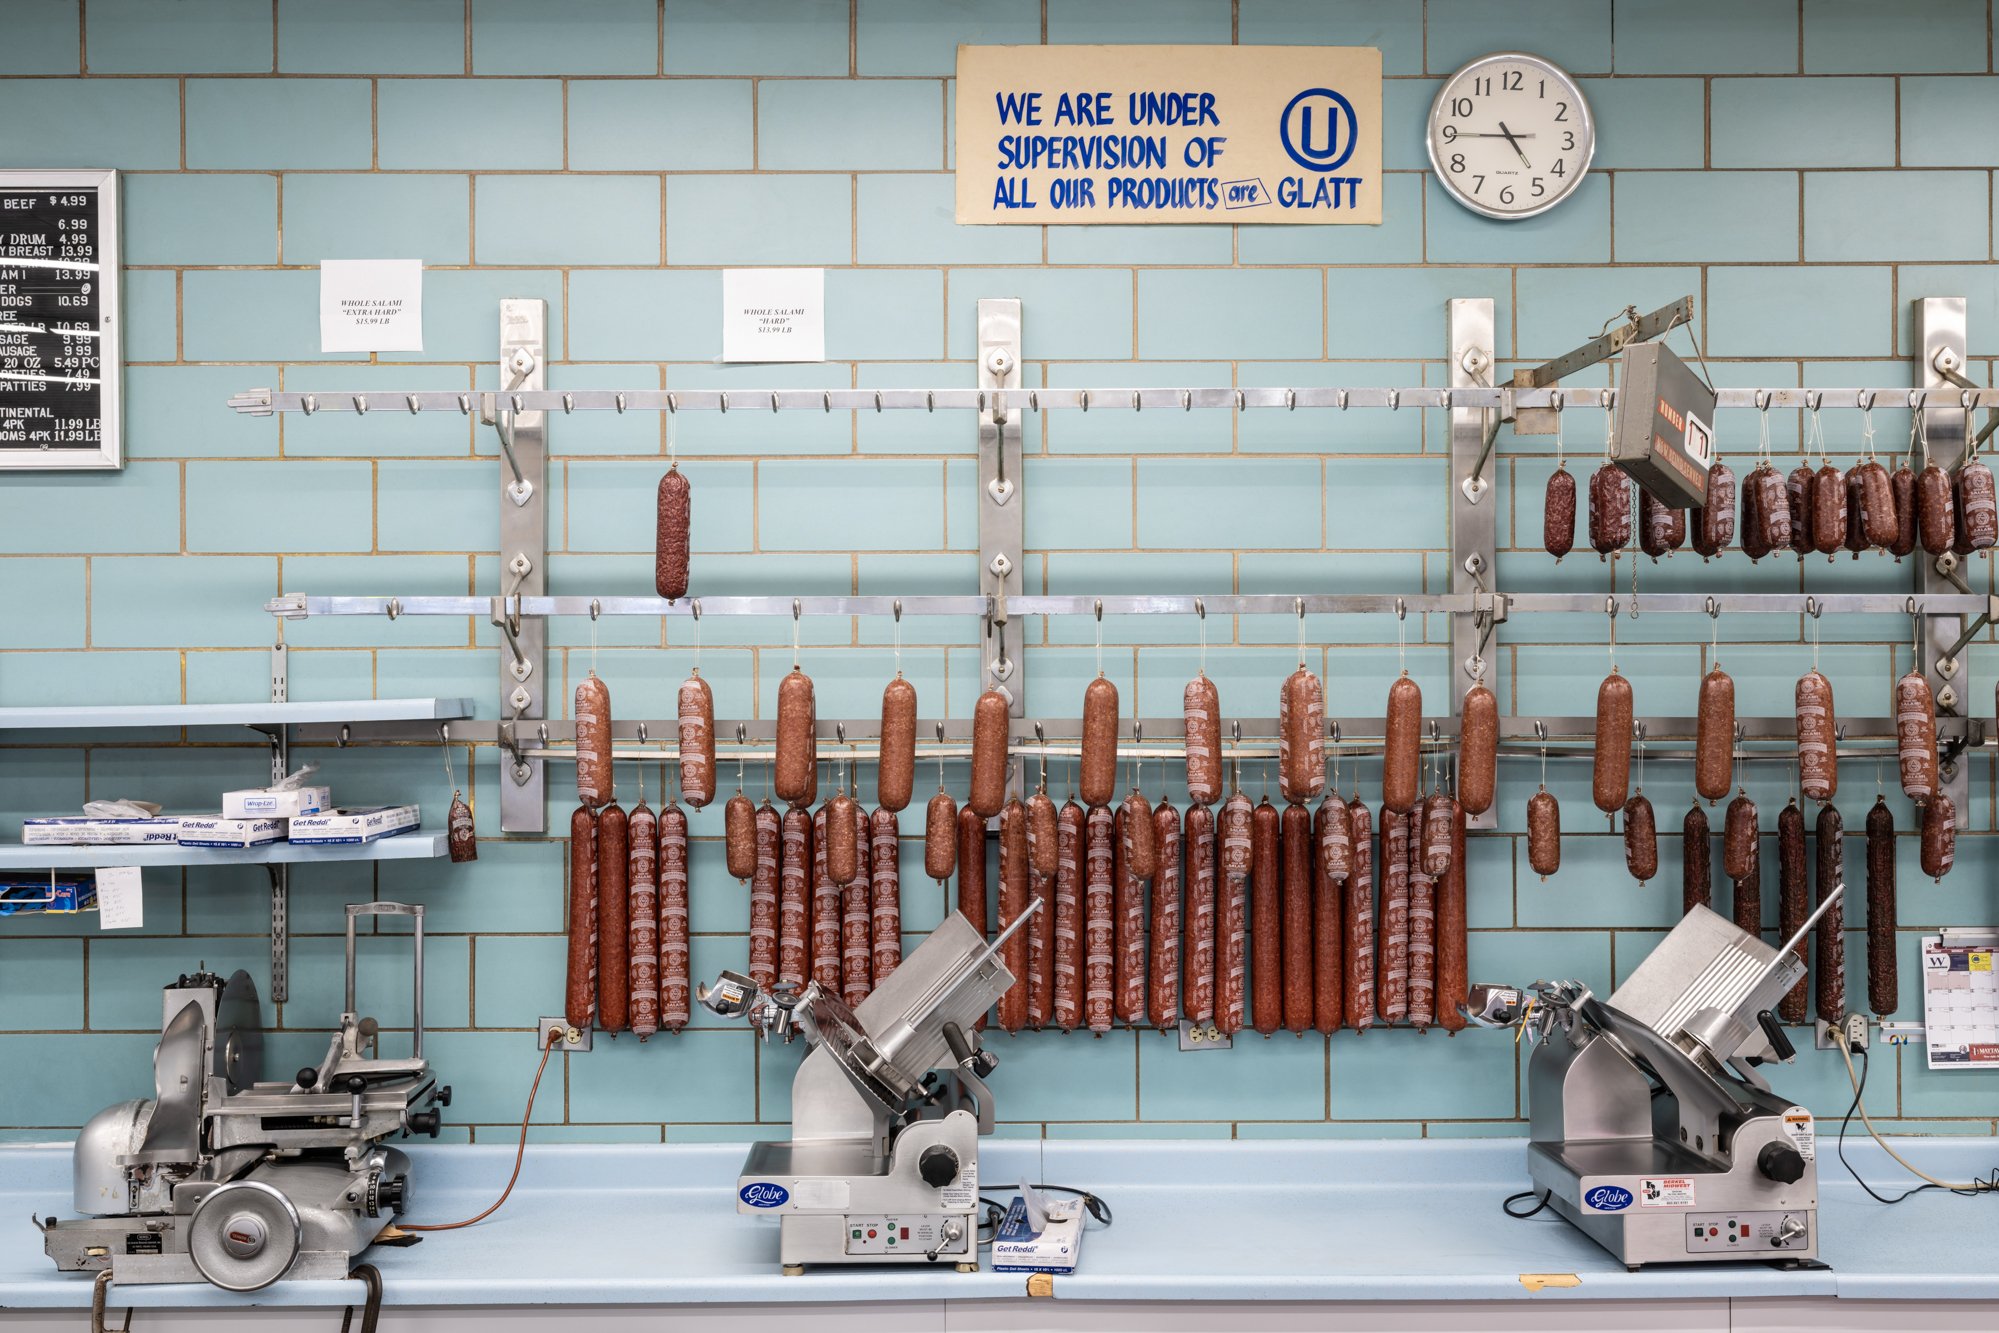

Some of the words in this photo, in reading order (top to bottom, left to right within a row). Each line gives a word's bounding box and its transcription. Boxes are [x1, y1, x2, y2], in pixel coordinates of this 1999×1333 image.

[1475, 77, 1491, 96] 11
[1502, 71, 1523, 91] 12
[1538, 79, 1545, 99] 1
[996, 91, 1042, 127] WE
[1054, 92, 1115, 127] ARE
[1129, 92, 1220, 127] UNDER
[1451, 97, 1473, 117] 10
[1554, 102, 1568, 122] 2
[1442, 125, 1458, 144] 9
[1561, 131, 1575, 151] 3
[997, 134, 1167, 170] SUPERVISION
[1183, 136, 1227, 169] OF
[1450, 153, 1466, 173] 8
[1550, 158, 1565, 178] 4
[993, 176, 1037, 210] ALL
[1049, 177, 1096, 209] OUR
[1108, 176, 1220, 210] PRODUCTS
[1228, 181, 1260, 203] are
[1277, 176, 1362, 209] GLATT
[1472, 175, 1485, 194] 7
[1531, 177, 1545, 197] 5
[4, 199, 37, 209] BEEF
[1500, 185, 1515, 205] 6
[58, 219, 88, 230] 6.99
[10, 233, 46, 245] DRUM
[59, 234, 87, 244] 4.99
[9, 246, 54, 256] BREAST
[60, 246, 93, 257] 13.99
[55, 269, 91, 280] 13.99
[1, 296, 32, 306] DOGS
[58, 296, 89, 306] 10.69
[63, 334, 92, 345] 9.99
[4, 358, 18, 368] 20
[24, 358, 41, 368] OZ
[54, 358, 79, 367] 5.49
[82, 357, 99, 367] PC
[0, 381, 47, 391] PATTIES
[65, 381, 91, 391] 7.99
[3, 420, 25, 429] 4PK
[54, 419, 83, 429] 11.99
[29, 431, 51, 440] 4PK
[54, 431, 83, 441] 11.99
[253, 823, 263, 832] Get
[1930, 957, 1945, 966] W
[745, 1185, 783, 1204] Globe
[1591, 1188, 1628, 1207] Globe
[997, 1245, 1012, 1253] Get
